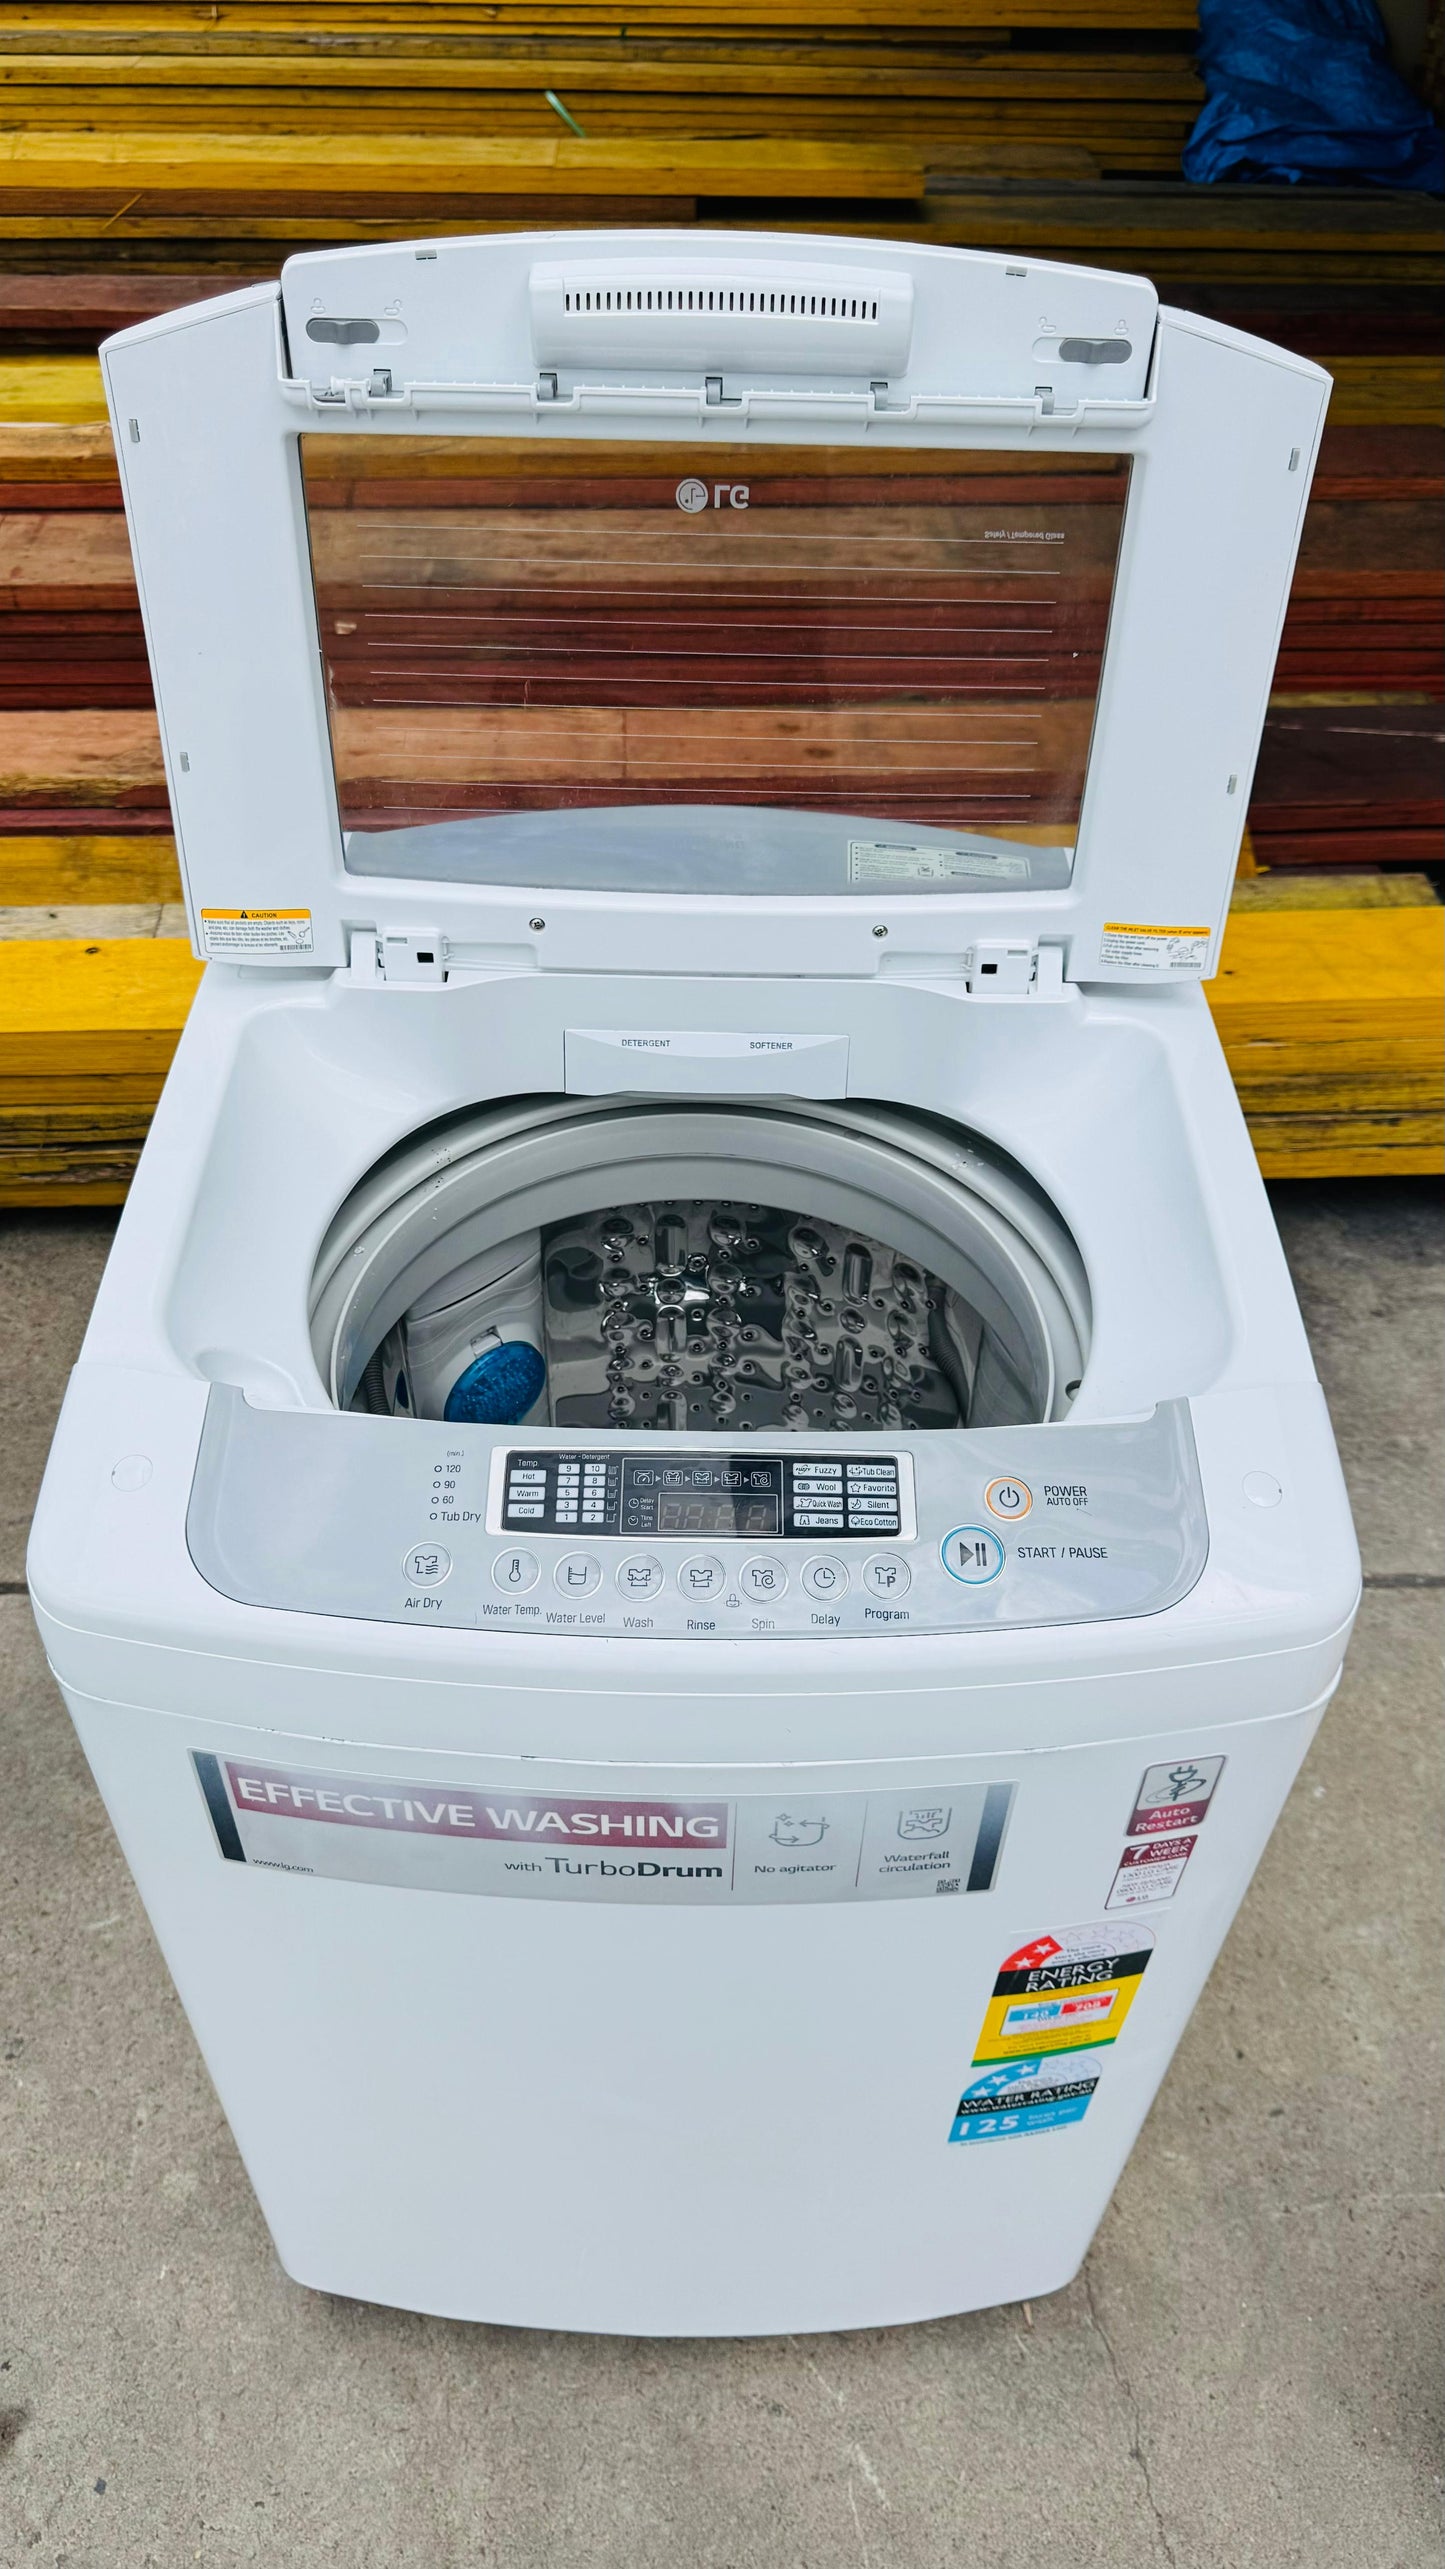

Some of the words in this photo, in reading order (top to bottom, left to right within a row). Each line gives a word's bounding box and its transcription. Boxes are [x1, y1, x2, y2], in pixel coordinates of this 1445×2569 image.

[621, 1039, 670, 1048] DETERGENT
[750, 1042, 793, 1050] SOFTENER
[446, 1464, 461, 1472] 120
[814, 1466, 836, 1475] Fuzzy
[876, 1468, 894, 1476] Clean
[522, 1472, 535, 1480] Hot
[444, 1480, 456, 1488] 90
[863, 1484, 895, 1492] Favorite
[1044, 1486, 1088, 1497] POWER
[442, 1496, 454, 1504] 60
[868, 1501, 890, 1509] Silent
[1046, 1498, 1070, 1506] AUTO
[1072, 1498, 1089, 1506] OFF
[518, 1506, 535, 1514] Cold
[441, 1512, 460, 1521] Tub
[462, 1512, 481, 1522] Dry
[816, 1516, 838, 1525] Jeans
[860, 1518, 873, 1526] Eco
[874, 1518, 896, 1526] Cotton
[1018, 1547, 1056, 1559] START
[1069, 1548, 1108, 1559] PAUSE
[404, 1598, 422, 1608] Air
[424, 1598, 442, 1610] Dry
[482, 1604, 513, 1616] Water
[515, 1604, 542, 1616] Temp.
[546, 1612, 577, 1624] Water
[579, 1612, 606, 1624] Level
[810, 1614, 841, 1626] Delay
[864, 1608, 910, 1621] Program
[623, 1616, 654, 1628] Wash
[687, 1619, 716, 1630] Rinse
[751, 1618, 775, 1630] Spin
[236, 1776, 476, 1828] EFFECTIVE
[486, 1806, 720, 1837] WASHING
[1150, 1807, 1190, 1820] Auto
[1135, 1815, 1198, 1832] Restart
[1130, 1844, 1150, 1860] 7
[1152, 1840, 1181, 1850] DAYS
[1150, 1844, 1188, 1858] WEEK
[884, 1850, 950, 1864] Waterfall
[252, 1858, 314, 1873] www.lg.com
[504, 1860, 542, 1872] with
[544, 1857, 723, 1878] TurboDrum
[754, 1865, 776, 1874] No
[779, 1864, 837, 1876] agitator
[879, 1860, 951, 1874] circulation
[1028, 1958, 1120, 1982] ENERGY
[1025, 1970, 1114, 1992] RATING
[962, 2094, 1024, 2108] WATER
[1030, 2080, 1096, 2098] RATING
[959, 2115, 1020, 2136] 125
